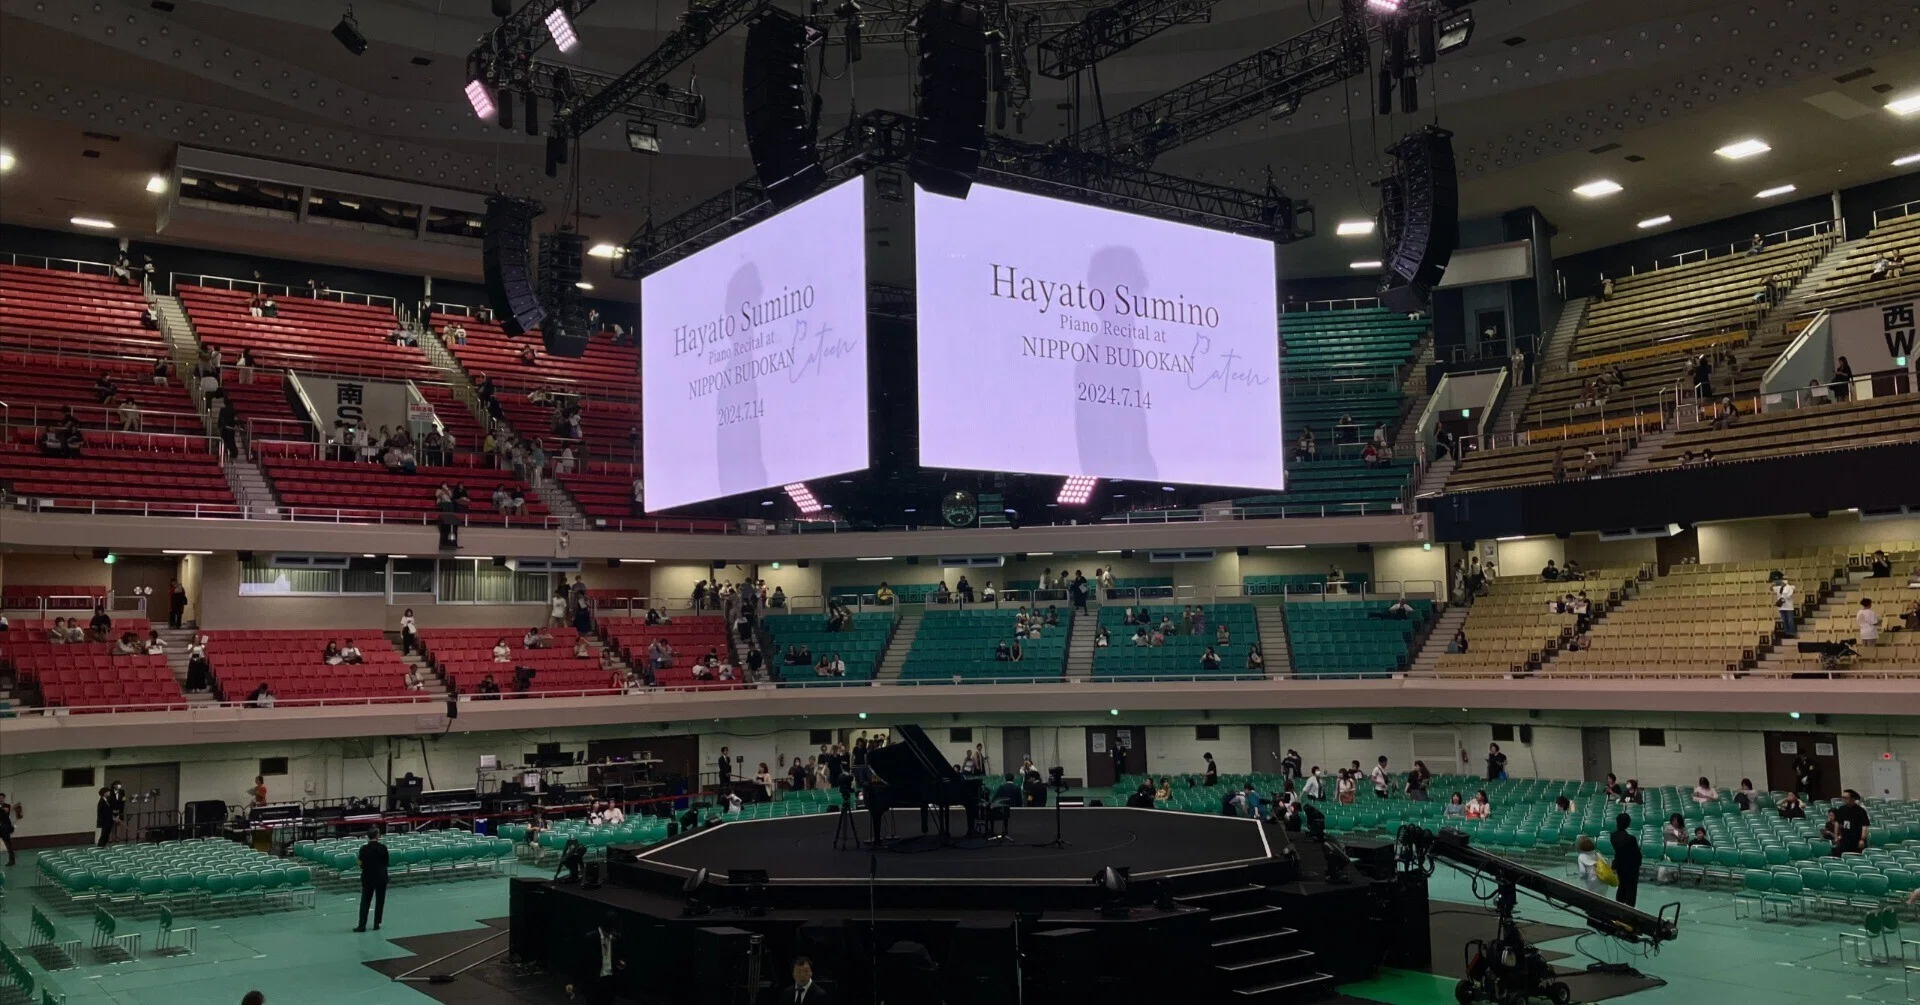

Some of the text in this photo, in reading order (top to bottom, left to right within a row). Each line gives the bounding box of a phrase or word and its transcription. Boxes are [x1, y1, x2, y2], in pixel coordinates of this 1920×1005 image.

[989, 263, 1219, 328] Hayato Sumino
[673, 285, 815, 357] Hayato Sumino
[1059, 314, 1166, 343] Piano Recital at
[1881, 303, 1914, 331] 西
[709, 331, 775, 365] Piano Recital at
[1022, 336, 1195, 374] NIPPON BUDOKAN
[1884, 328, 1915, 357] W
[689, 347, 796, 400] NIPPON BUDOKAN
[337, 383, 364, 405] 南
[1078, 382, 1152, 409] 2024.7.14
[337, 406, 363, 426] S
[718, 399, 764, 426] 2024.7.14
